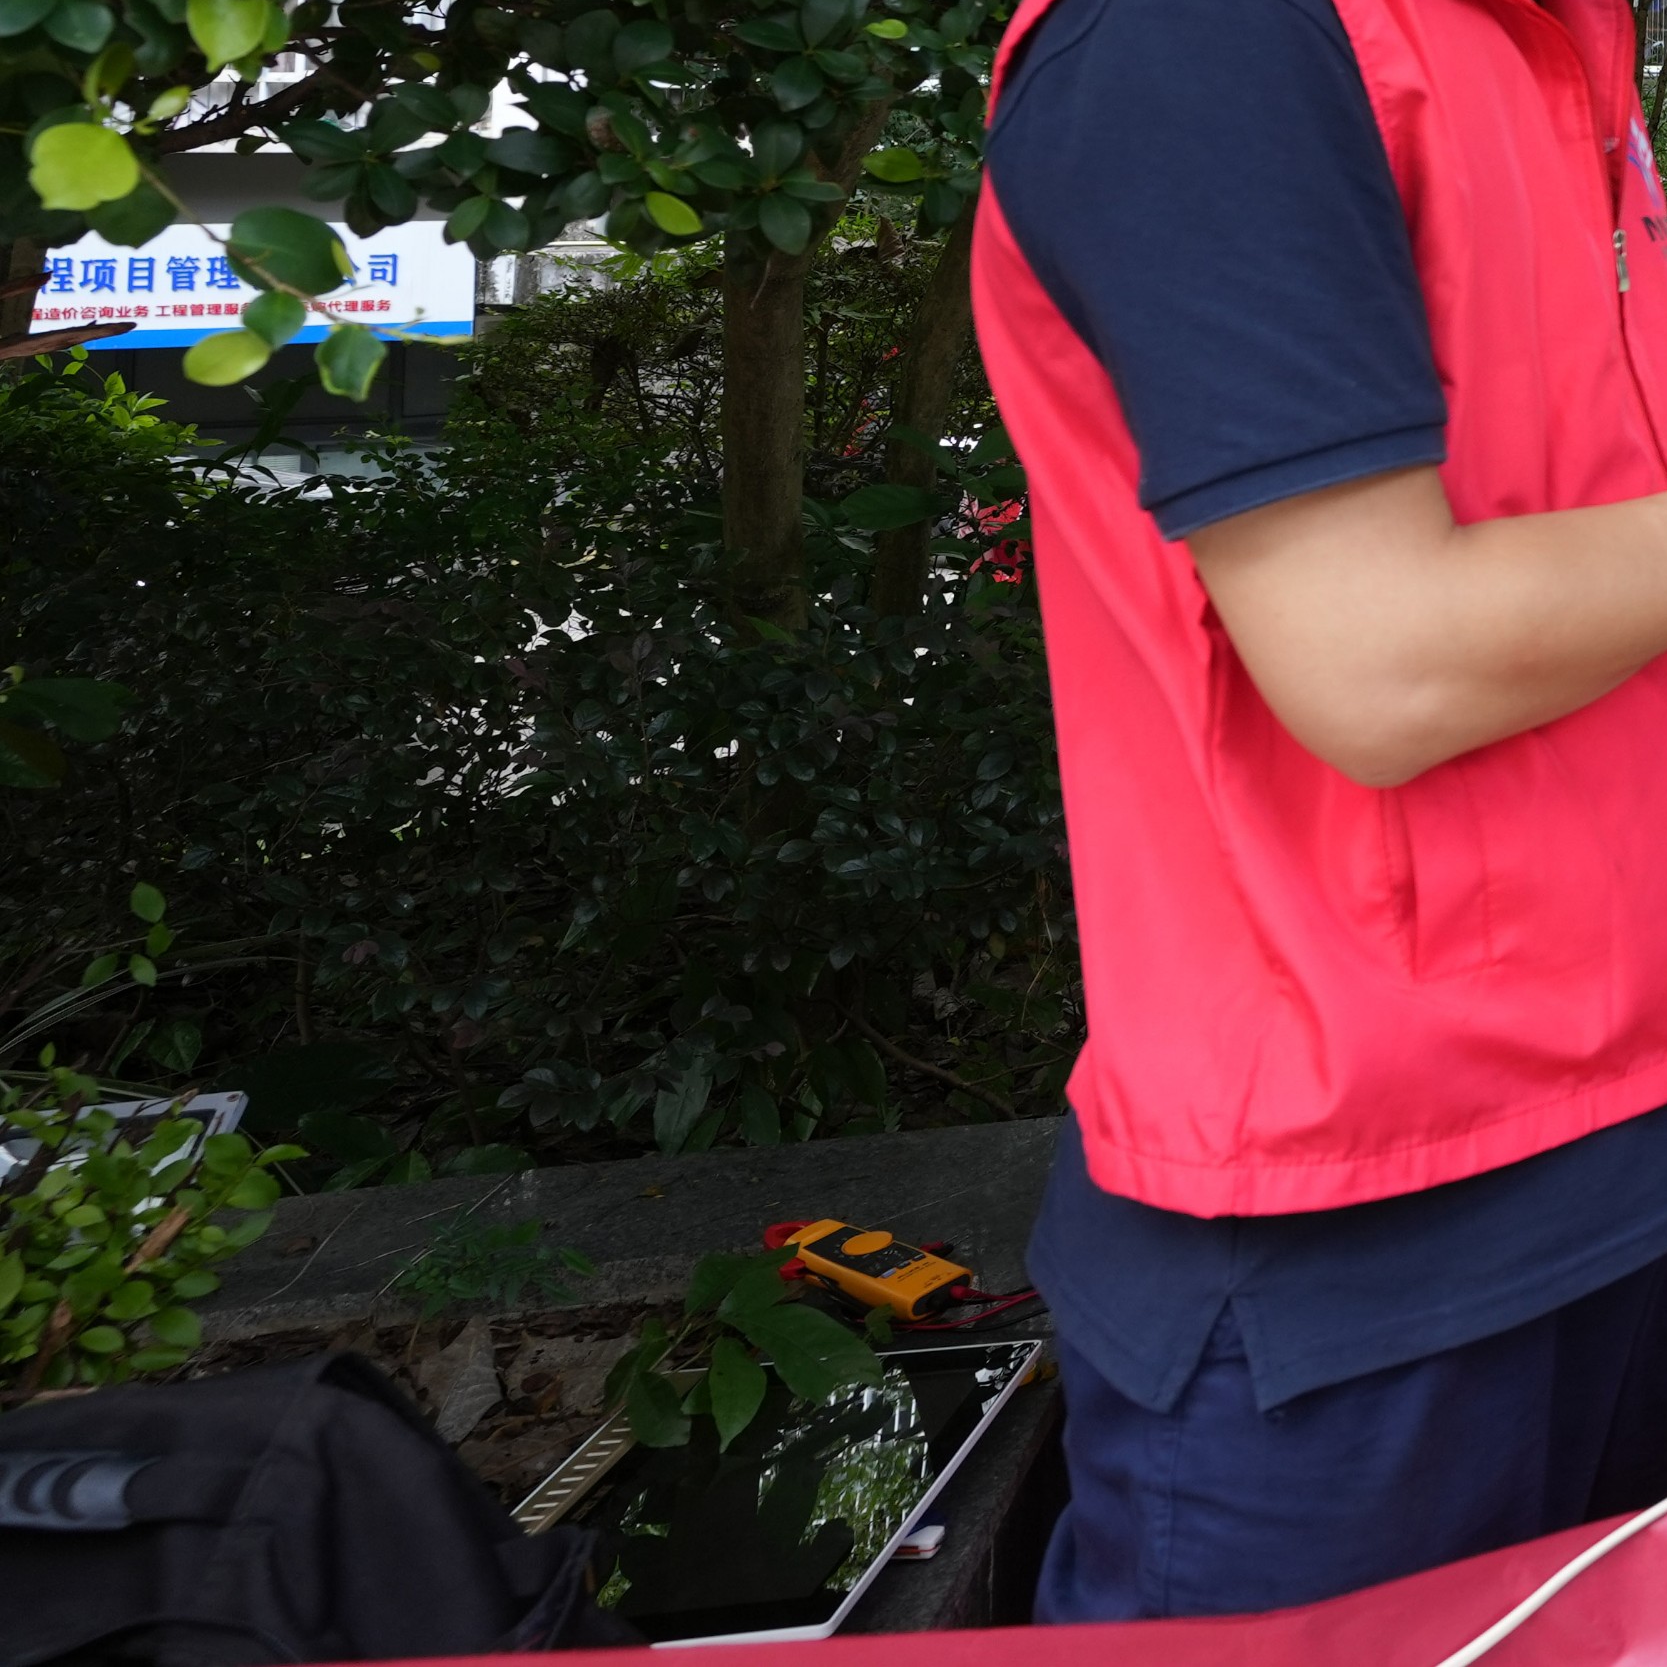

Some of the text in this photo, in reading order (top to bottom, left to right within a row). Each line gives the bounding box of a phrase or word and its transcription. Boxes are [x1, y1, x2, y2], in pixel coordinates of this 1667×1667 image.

[40, 253, 398, 294] 程项目管理司
